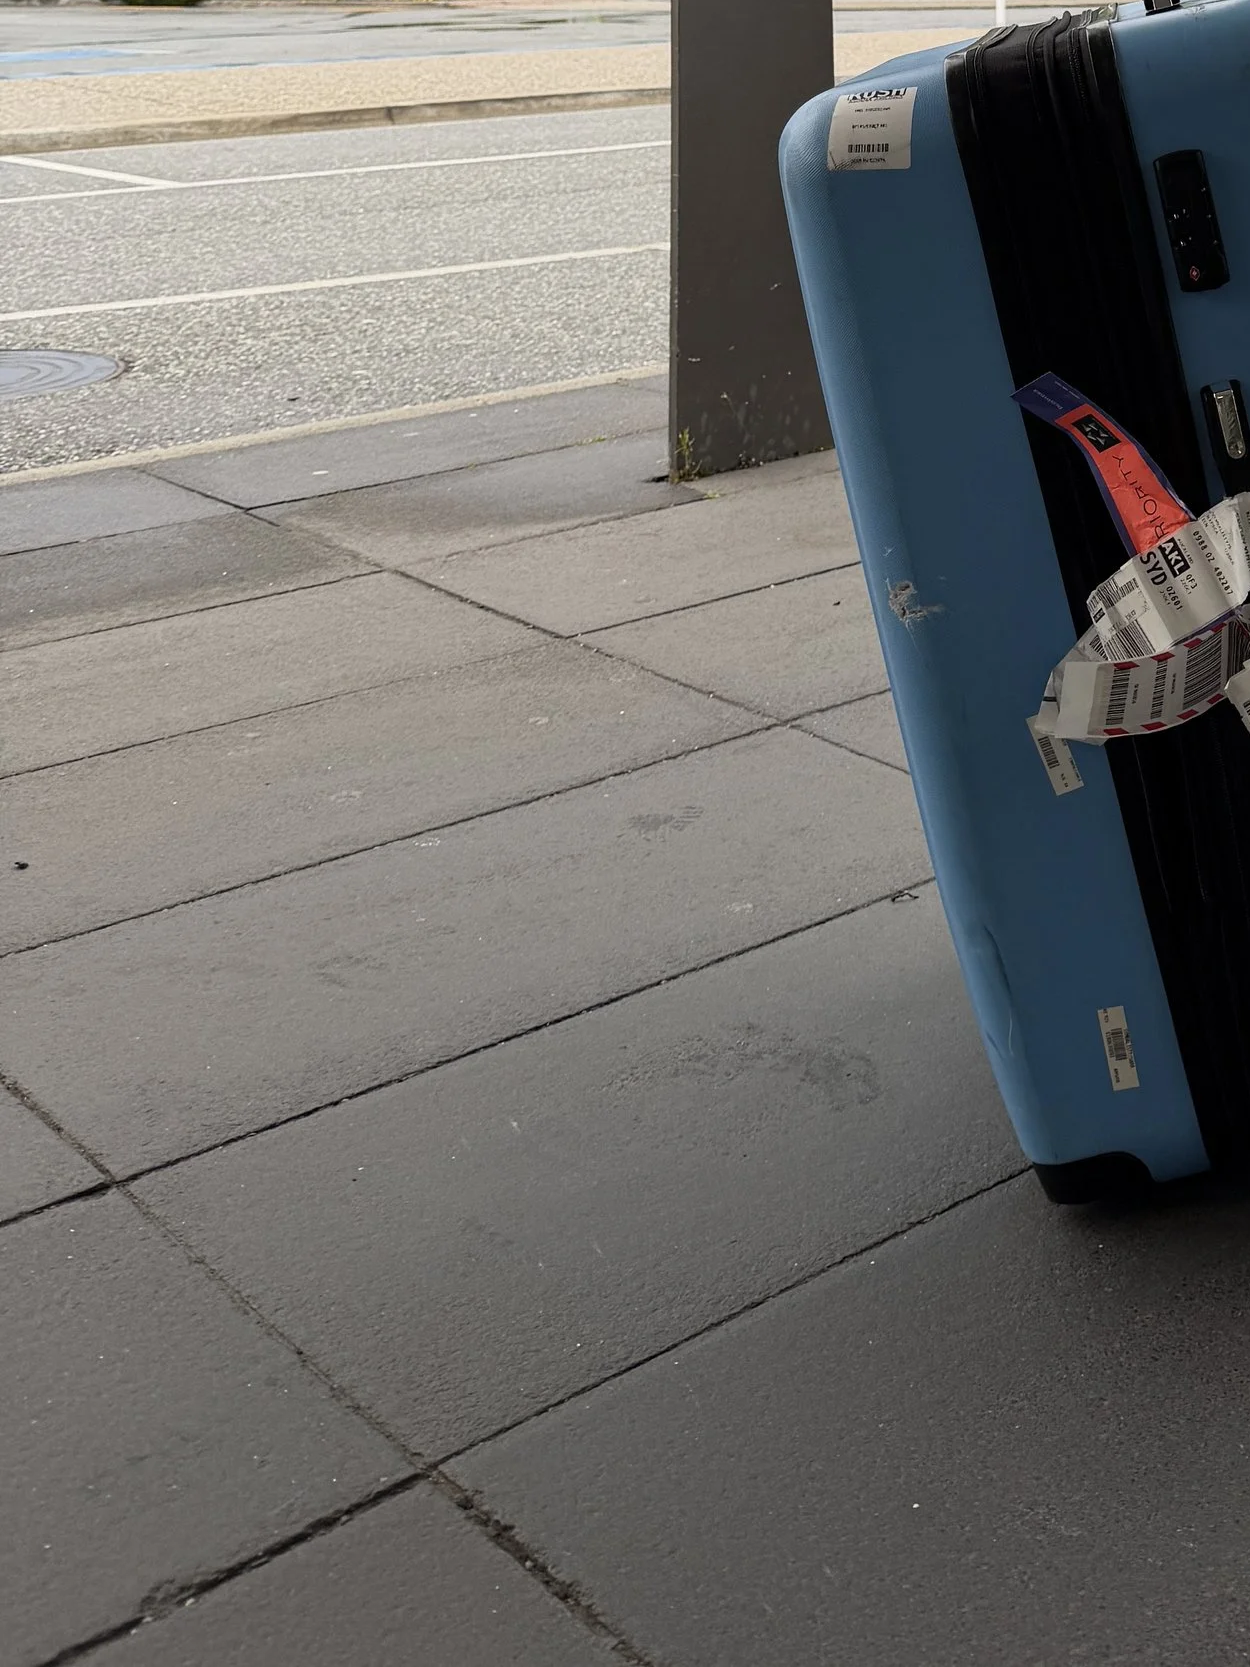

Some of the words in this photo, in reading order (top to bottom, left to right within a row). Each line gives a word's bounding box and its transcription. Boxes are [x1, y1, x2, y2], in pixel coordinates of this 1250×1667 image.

[1112, 454, 1170, 540] RIORITY
[1193, 530, 1208, 551] 0988
[1140, 551, 1168, 586] SYD
[1161, 541, 1185, 575] AKL
